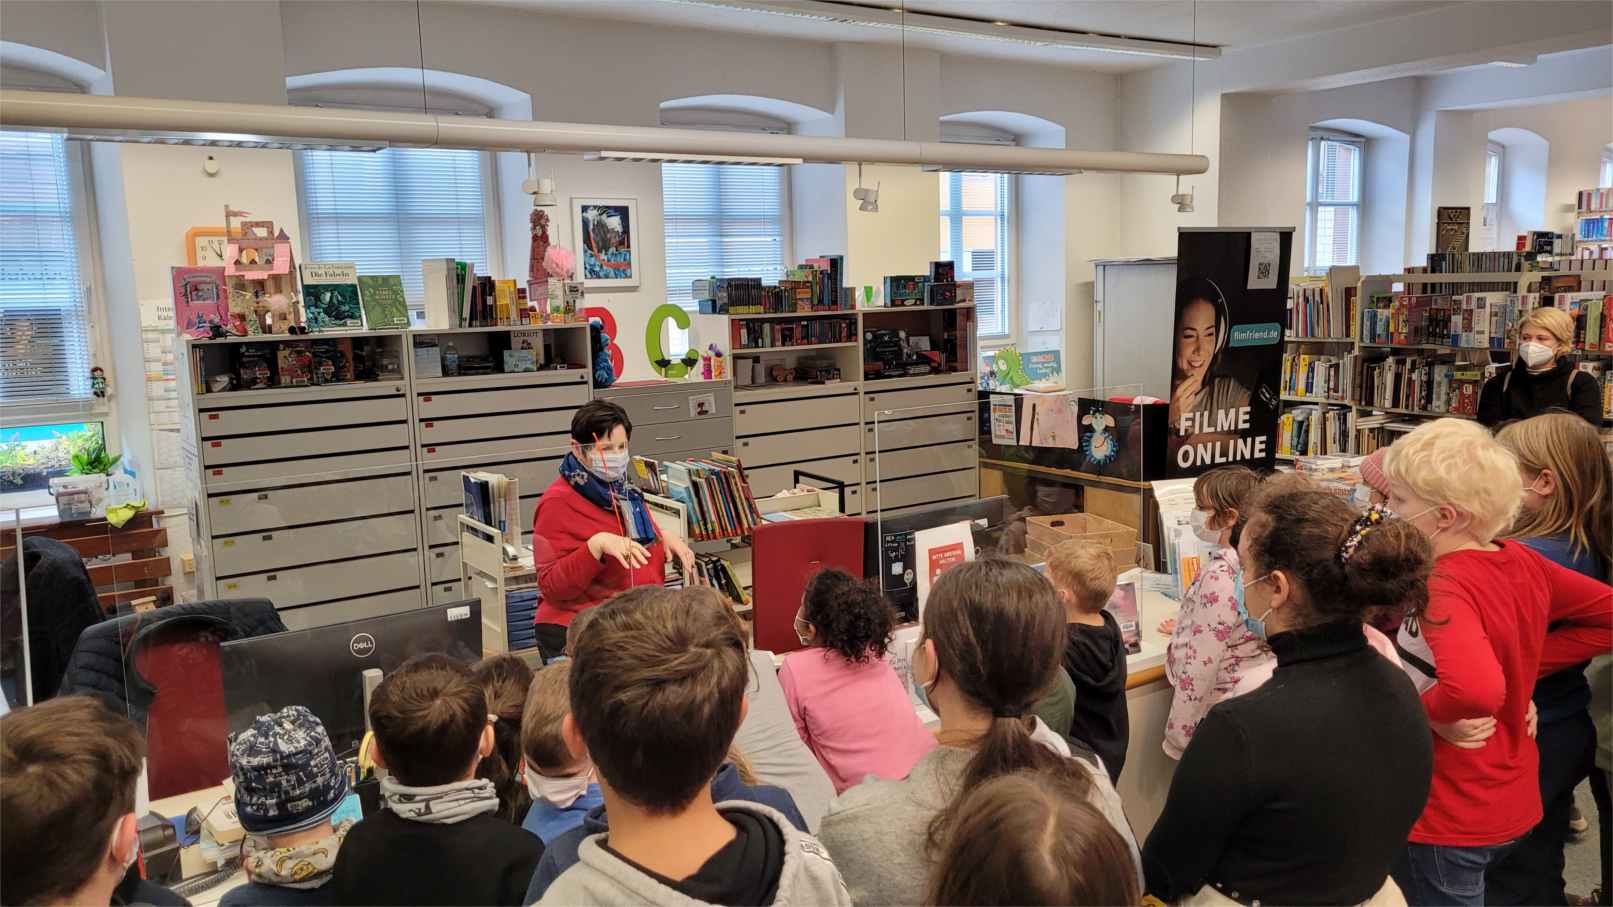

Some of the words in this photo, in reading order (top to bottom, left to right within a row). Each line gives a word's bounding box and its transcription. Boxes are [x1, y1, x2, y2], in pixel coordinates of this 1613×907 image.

[324, 270, 350, 278] Fabeln
[1233, 329, 1278, 341] filmfriend.de
[645, 304, 699, 379] C
[1179, 406, 1251, 436] FILME
[1177, 435, 1267, 468] ONLINE
[944, 549, 962, 558] ABSTAND
[353, 640, 373, 650] DELL
